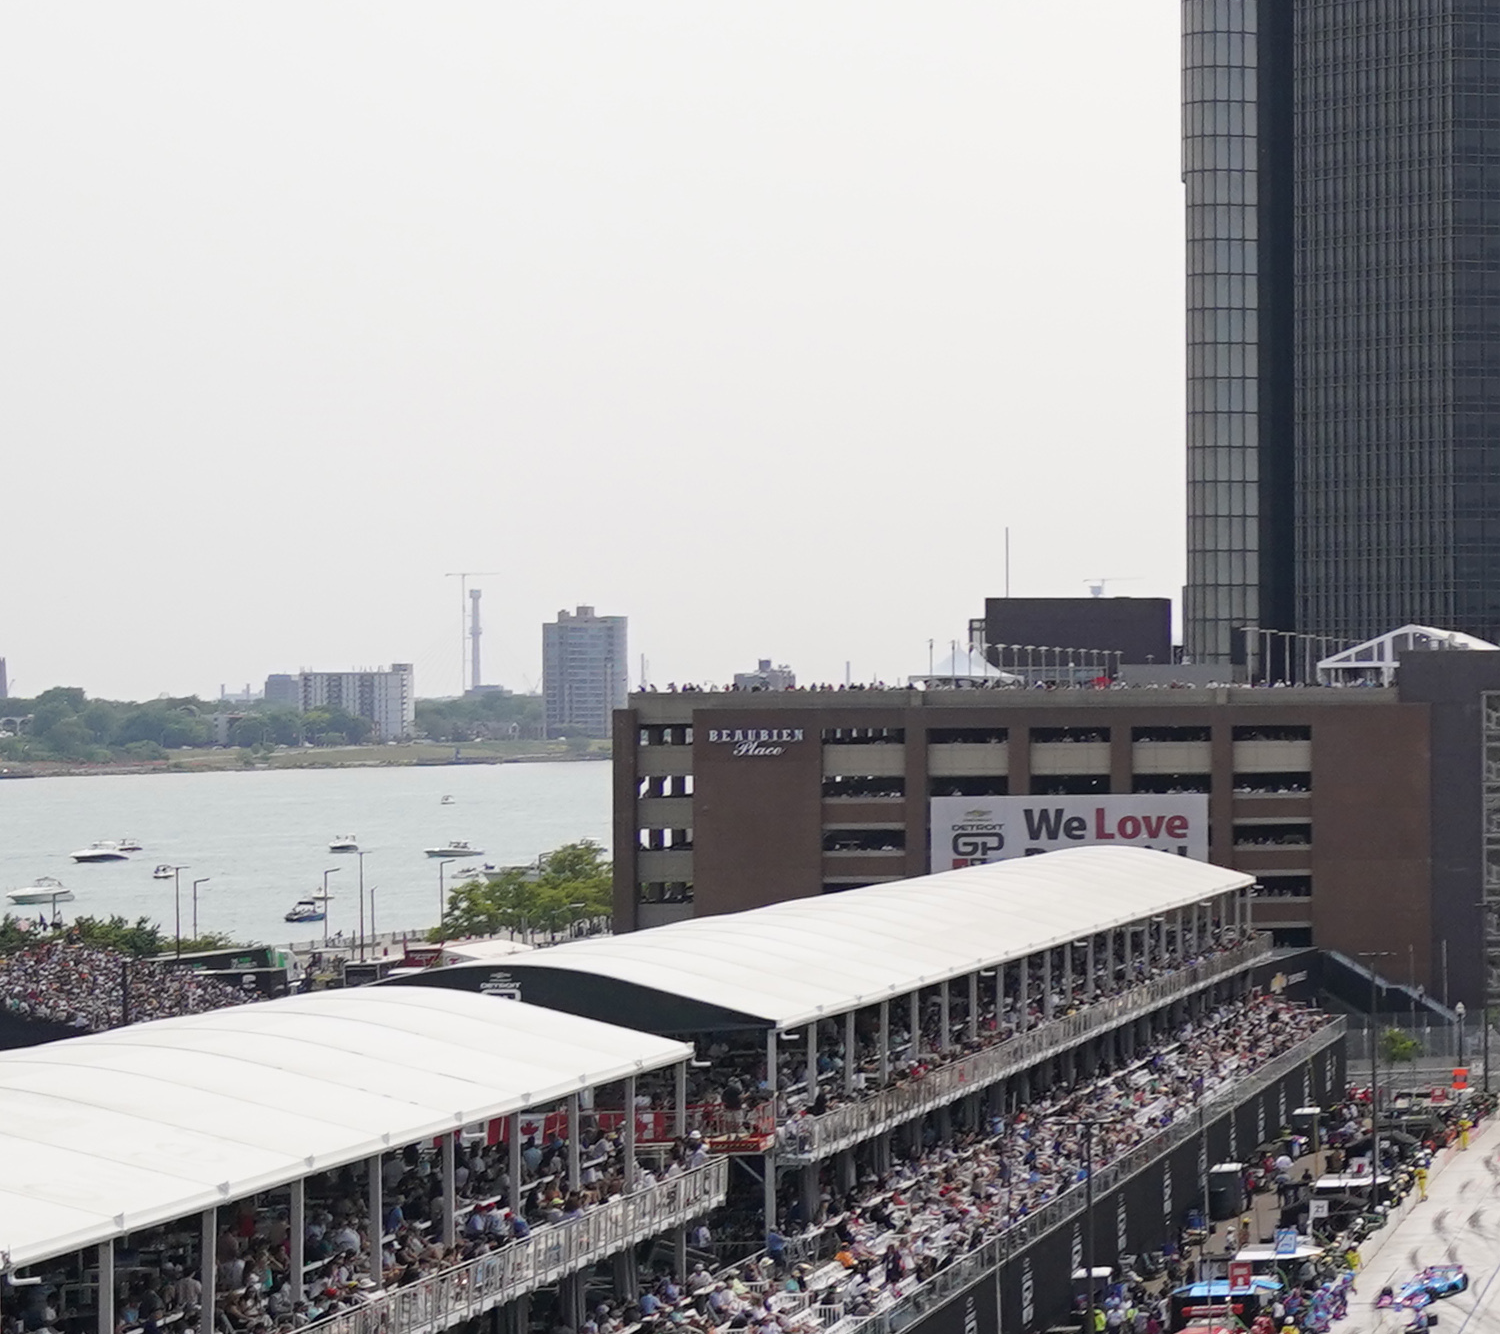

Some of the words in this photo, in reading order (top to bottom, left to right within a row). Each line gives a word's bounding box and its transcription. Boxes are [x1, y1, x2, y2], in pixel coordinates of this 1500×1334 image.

[708, 729, 804, 743] BEAUBIEN
[1023, 808, 1087, 841] We
[1095, 807, 1188, 840] Love
[952, 832, 1005, 857] GP
